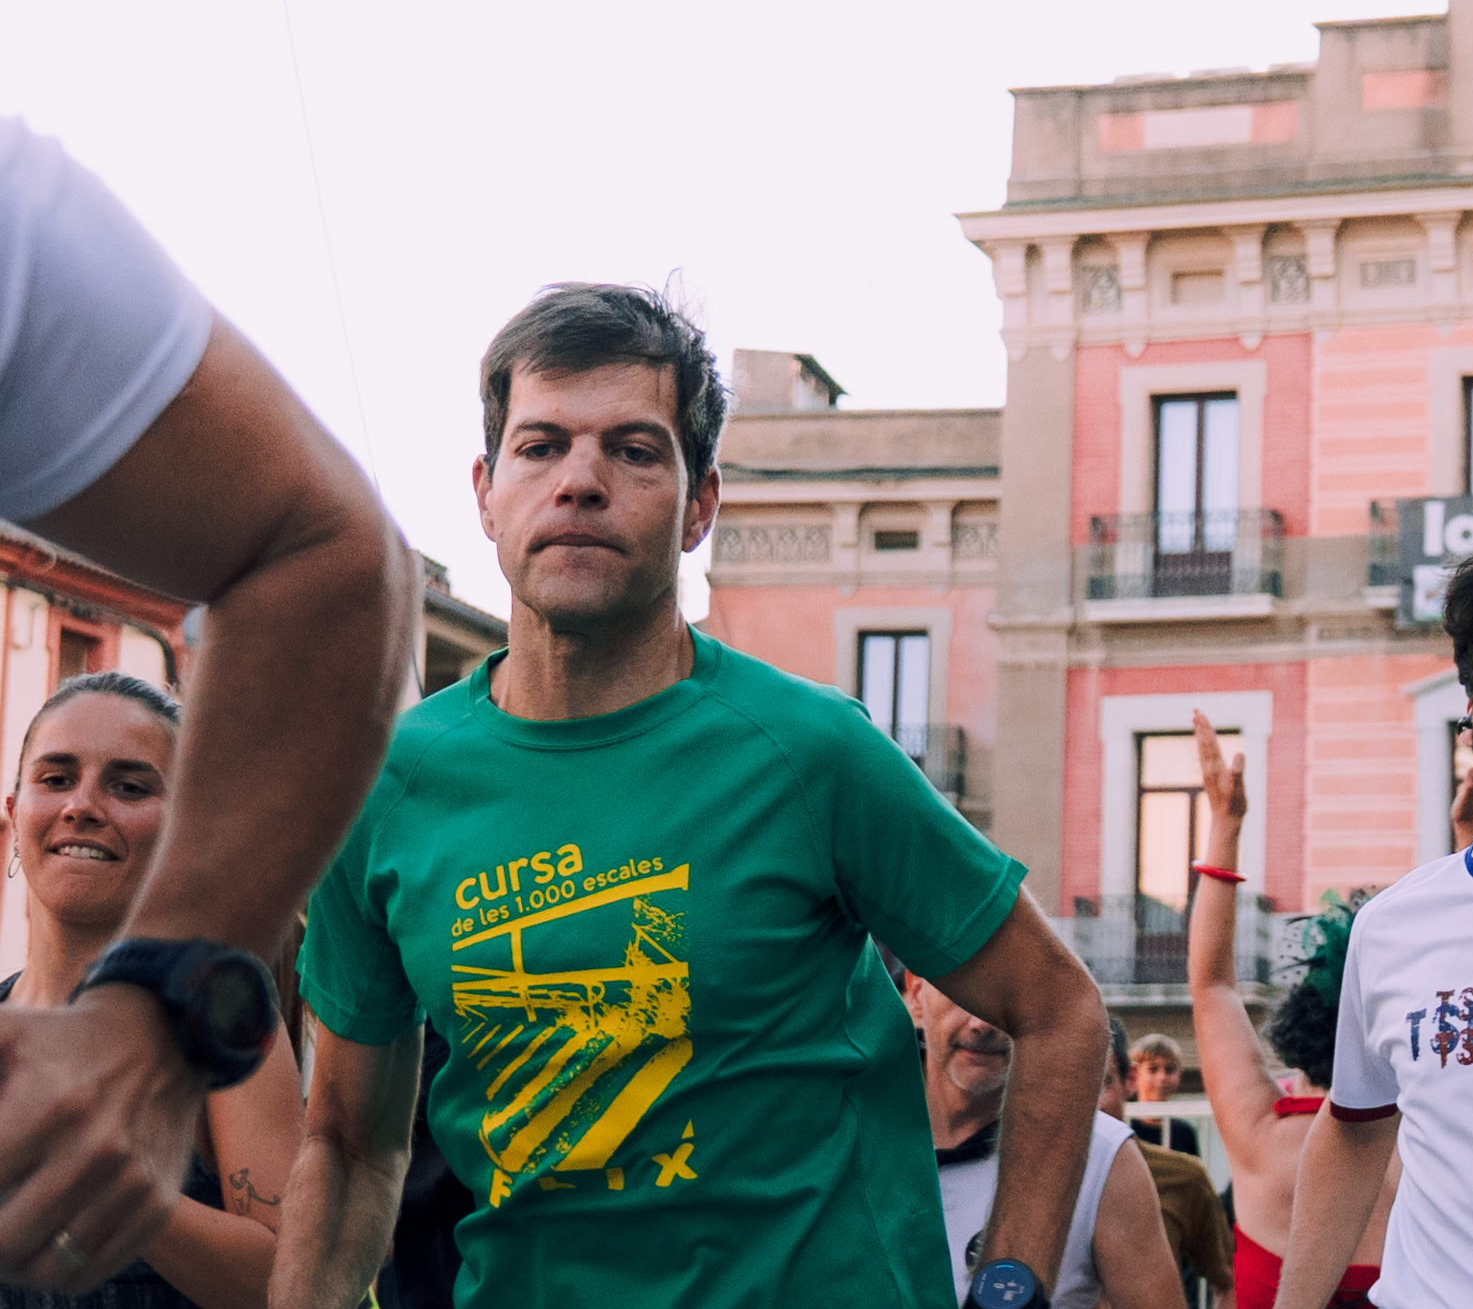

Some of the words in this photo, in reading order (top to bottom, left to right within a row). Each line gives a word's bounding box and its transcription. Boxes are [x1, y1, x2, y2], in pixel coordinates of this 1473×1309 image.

[451, 917, 474, 937] de
[479, 904, 510, 926] les
[515, 880, 575, 913] 1.000
[583, 857, 664, 891] escales
[455, 843, 583, 910] cursa
